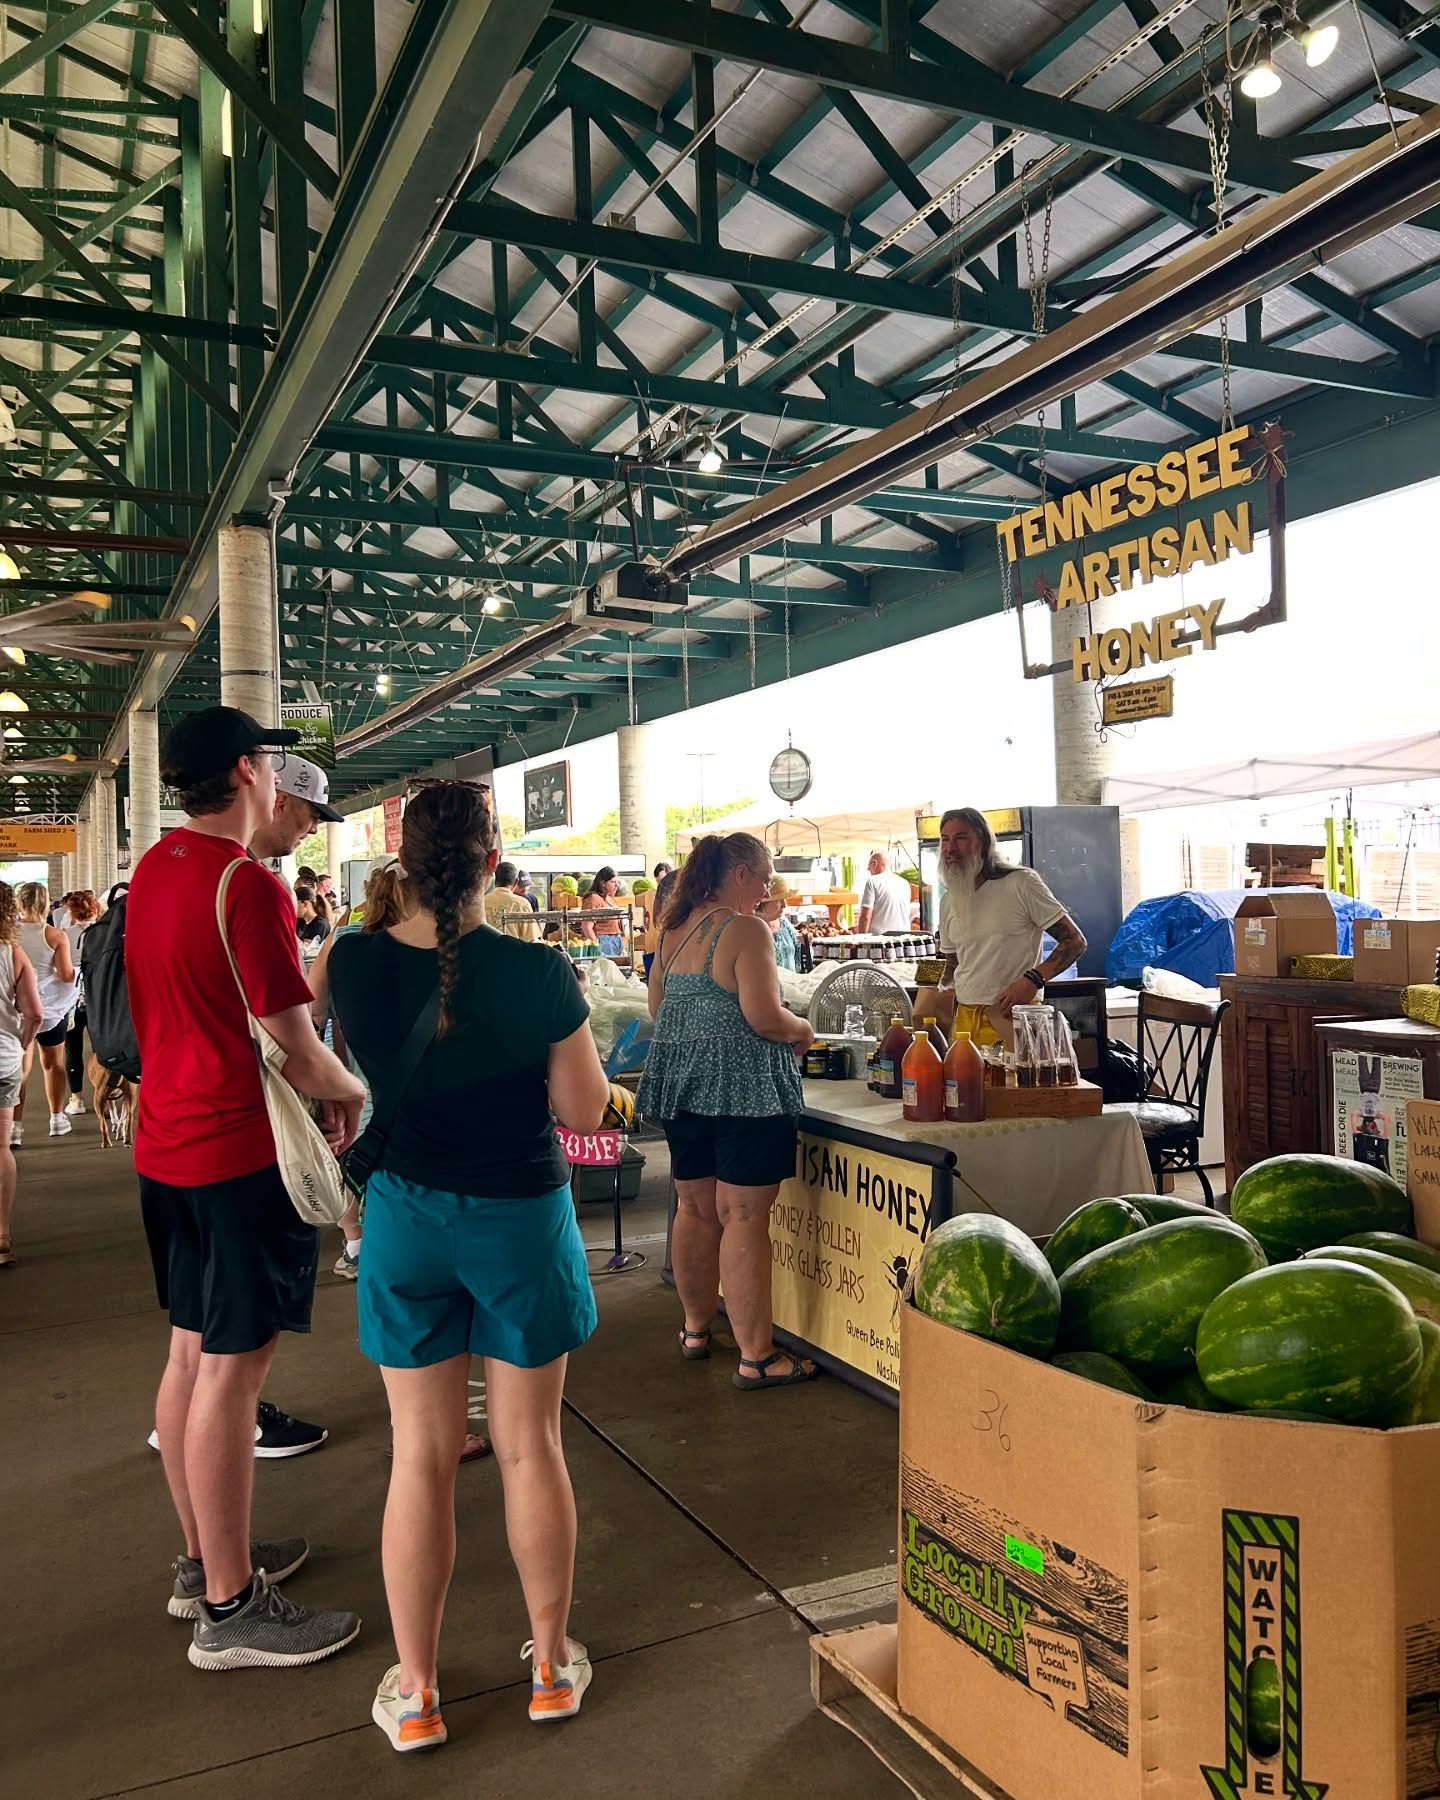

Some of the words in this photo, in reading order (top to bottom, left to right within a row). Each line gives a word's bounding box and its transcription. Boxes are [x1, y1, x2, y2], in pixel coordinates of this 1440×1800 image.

[996, 424, 1252, 563] TENNESSEE
[1056, 501, 1254, 611] ARTISAN
[1071, 598, 1227, 683] HONEY
[1335, 1057, 1357, 1066] MEAD
[1382, 1061, 1420, 1073] BREWING
[1335, 1067, 1358, 1076] MEAD
[1338, 1100, 1347, 1114] DIE
[1338, 1116, 1346, 1131] OR
[557, 1132, 616, 1161] OME
[1339, 1132, 1347, 1154] BEES
[797, 1140, 849, 1198] ISAN
[856, 1162, 933, 1244] HONEY
[768, 1201, 804, 1238] HONEY
[806, 1210, 814, 1242] &
[816, 1215, 862, 1260] POLLEN
[772, 1239, 795, 1274] OUR
[798, 1249, 833, 1290] GLASS
[836, 1263, 865, 1304] JARS
[846, 1318, 869, 1344] Queen
[870, 1328, 885, 1351] Bee
[970, 1388, 1011, 1452] 36
[903, 1507, 1031, 1639] Locally
[903, 1555, 1019, 1672] Grown
[1026, 1630, 1080, 1664] Supporting
[1040, 1650, 1068, 1672] Local
[1036, 1667, 1077, 1692] Farmers
